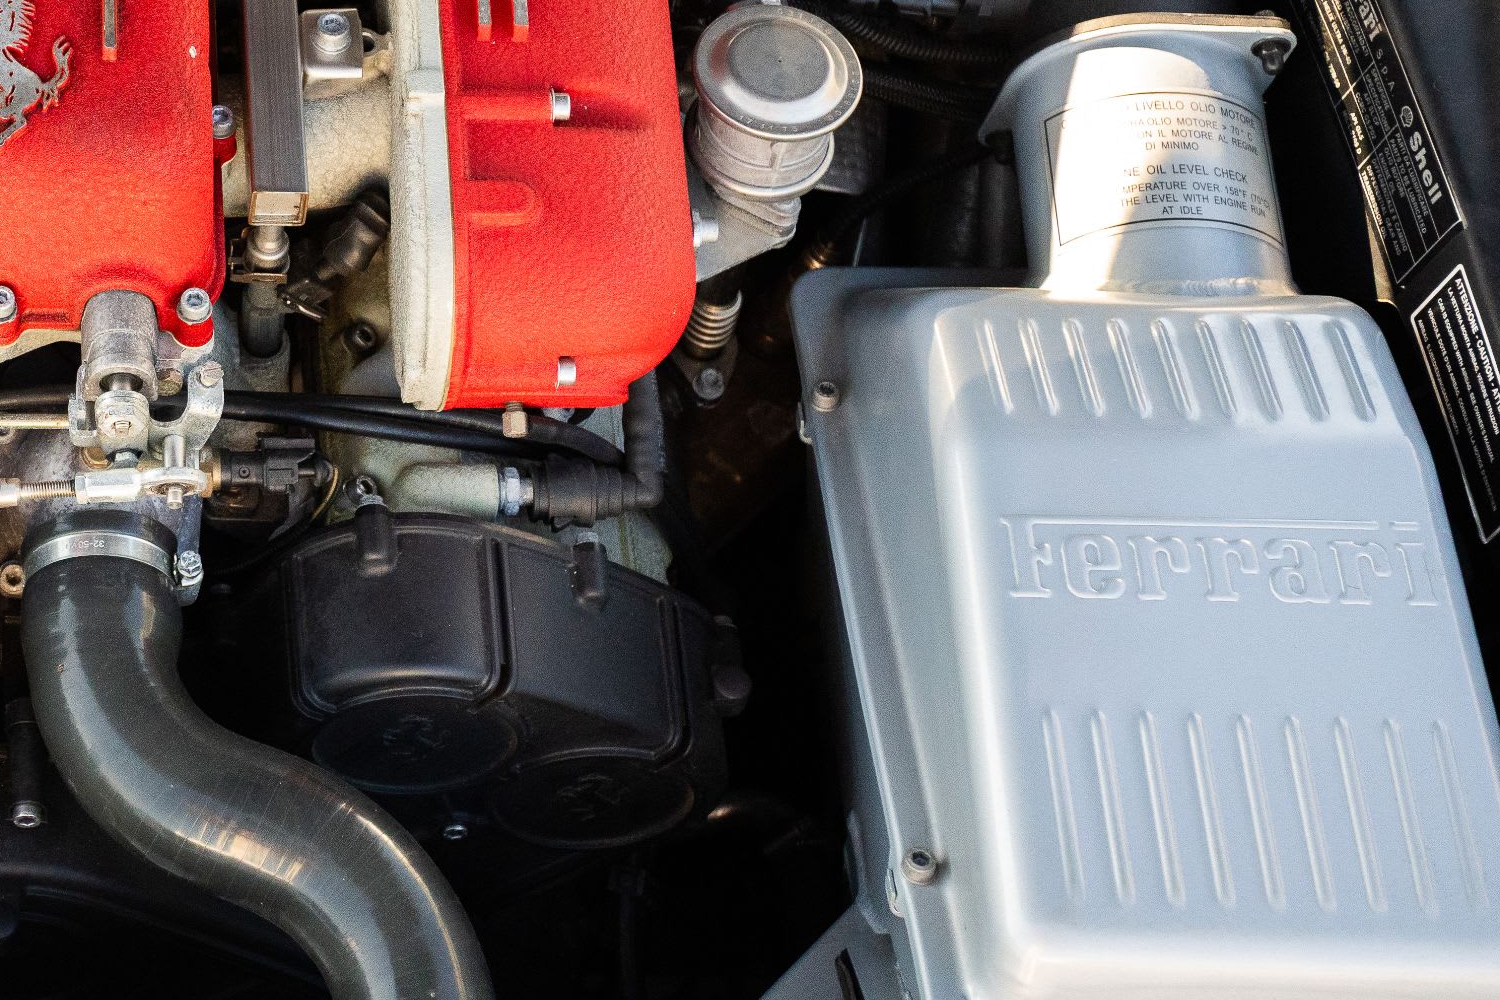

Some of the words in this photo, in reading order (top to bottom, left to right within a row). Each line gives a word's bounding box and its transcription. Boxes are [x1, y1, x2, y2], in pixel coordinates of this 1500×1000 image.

[1331, 21, 1343, 43] ULTRA
[1135, 100, 1185, 112] LIVELLO
[1190, 101, 1216, 114] OLIO
[1220, 106, 1257, 130] MOTORE
[1147, 116, 1172, 126] OLIO
[1177, 117, 1218, 131] MOTORE
[1145, 142, 1156, 151] DI
[1161, 141, 1200, 151] MINIMO
[1157, 130, 1166, 138] IL
[1171, 129, 1214, 141] MOTORE
[1217, 135, 1228, 145] AL
[1146, 164, 1166, 176] OIL
[1171, 163, 1210, 176] LEVEL
[1214, 166, 1249, 184] CHECK
[1383, 146, 1393, 165] OLIO
[1390, 165, 1405, 198] MOTORE
[1403, 153, 1411, 168] DA
[1408, 131, 1441, 203] Shell
[1122, 180, 1188, 194] MPERATURE
[1361, 171, 1382, 225] TRANSMISSION
[1398, 162, 1406, 175] TO
[1407, 186, 1426, 234] LUBRICATED
[1120, 195, 1141, 208] THE
[1145, 193, 1180, 204] LEVEL
[1183, 193, 1210, 204] WITH
[1214, 195, 1248, 212] ENGINE
[1161, 205, 1174, 216] AT
[1179, 205, 1203, 215] IDLE
[1441, 310, 1447, 320] IS
[1444, 318, 1458, 350] EQUIPPED
[1455, 349, 1463, 368] WITH
[1455, 276, 1478, 334] ATTENZIONE
[1477, 337, 1493, 384] CAUTION
[1447, 286, 1453, 297] LA
[1450, 296, 1463, 324] VETTURA
[1460, 323, 1471, 348] MONTA
[1484, 396, 1499, 438] ISTRUZIONI
[999, 514, 1440, 608] Ferrari
